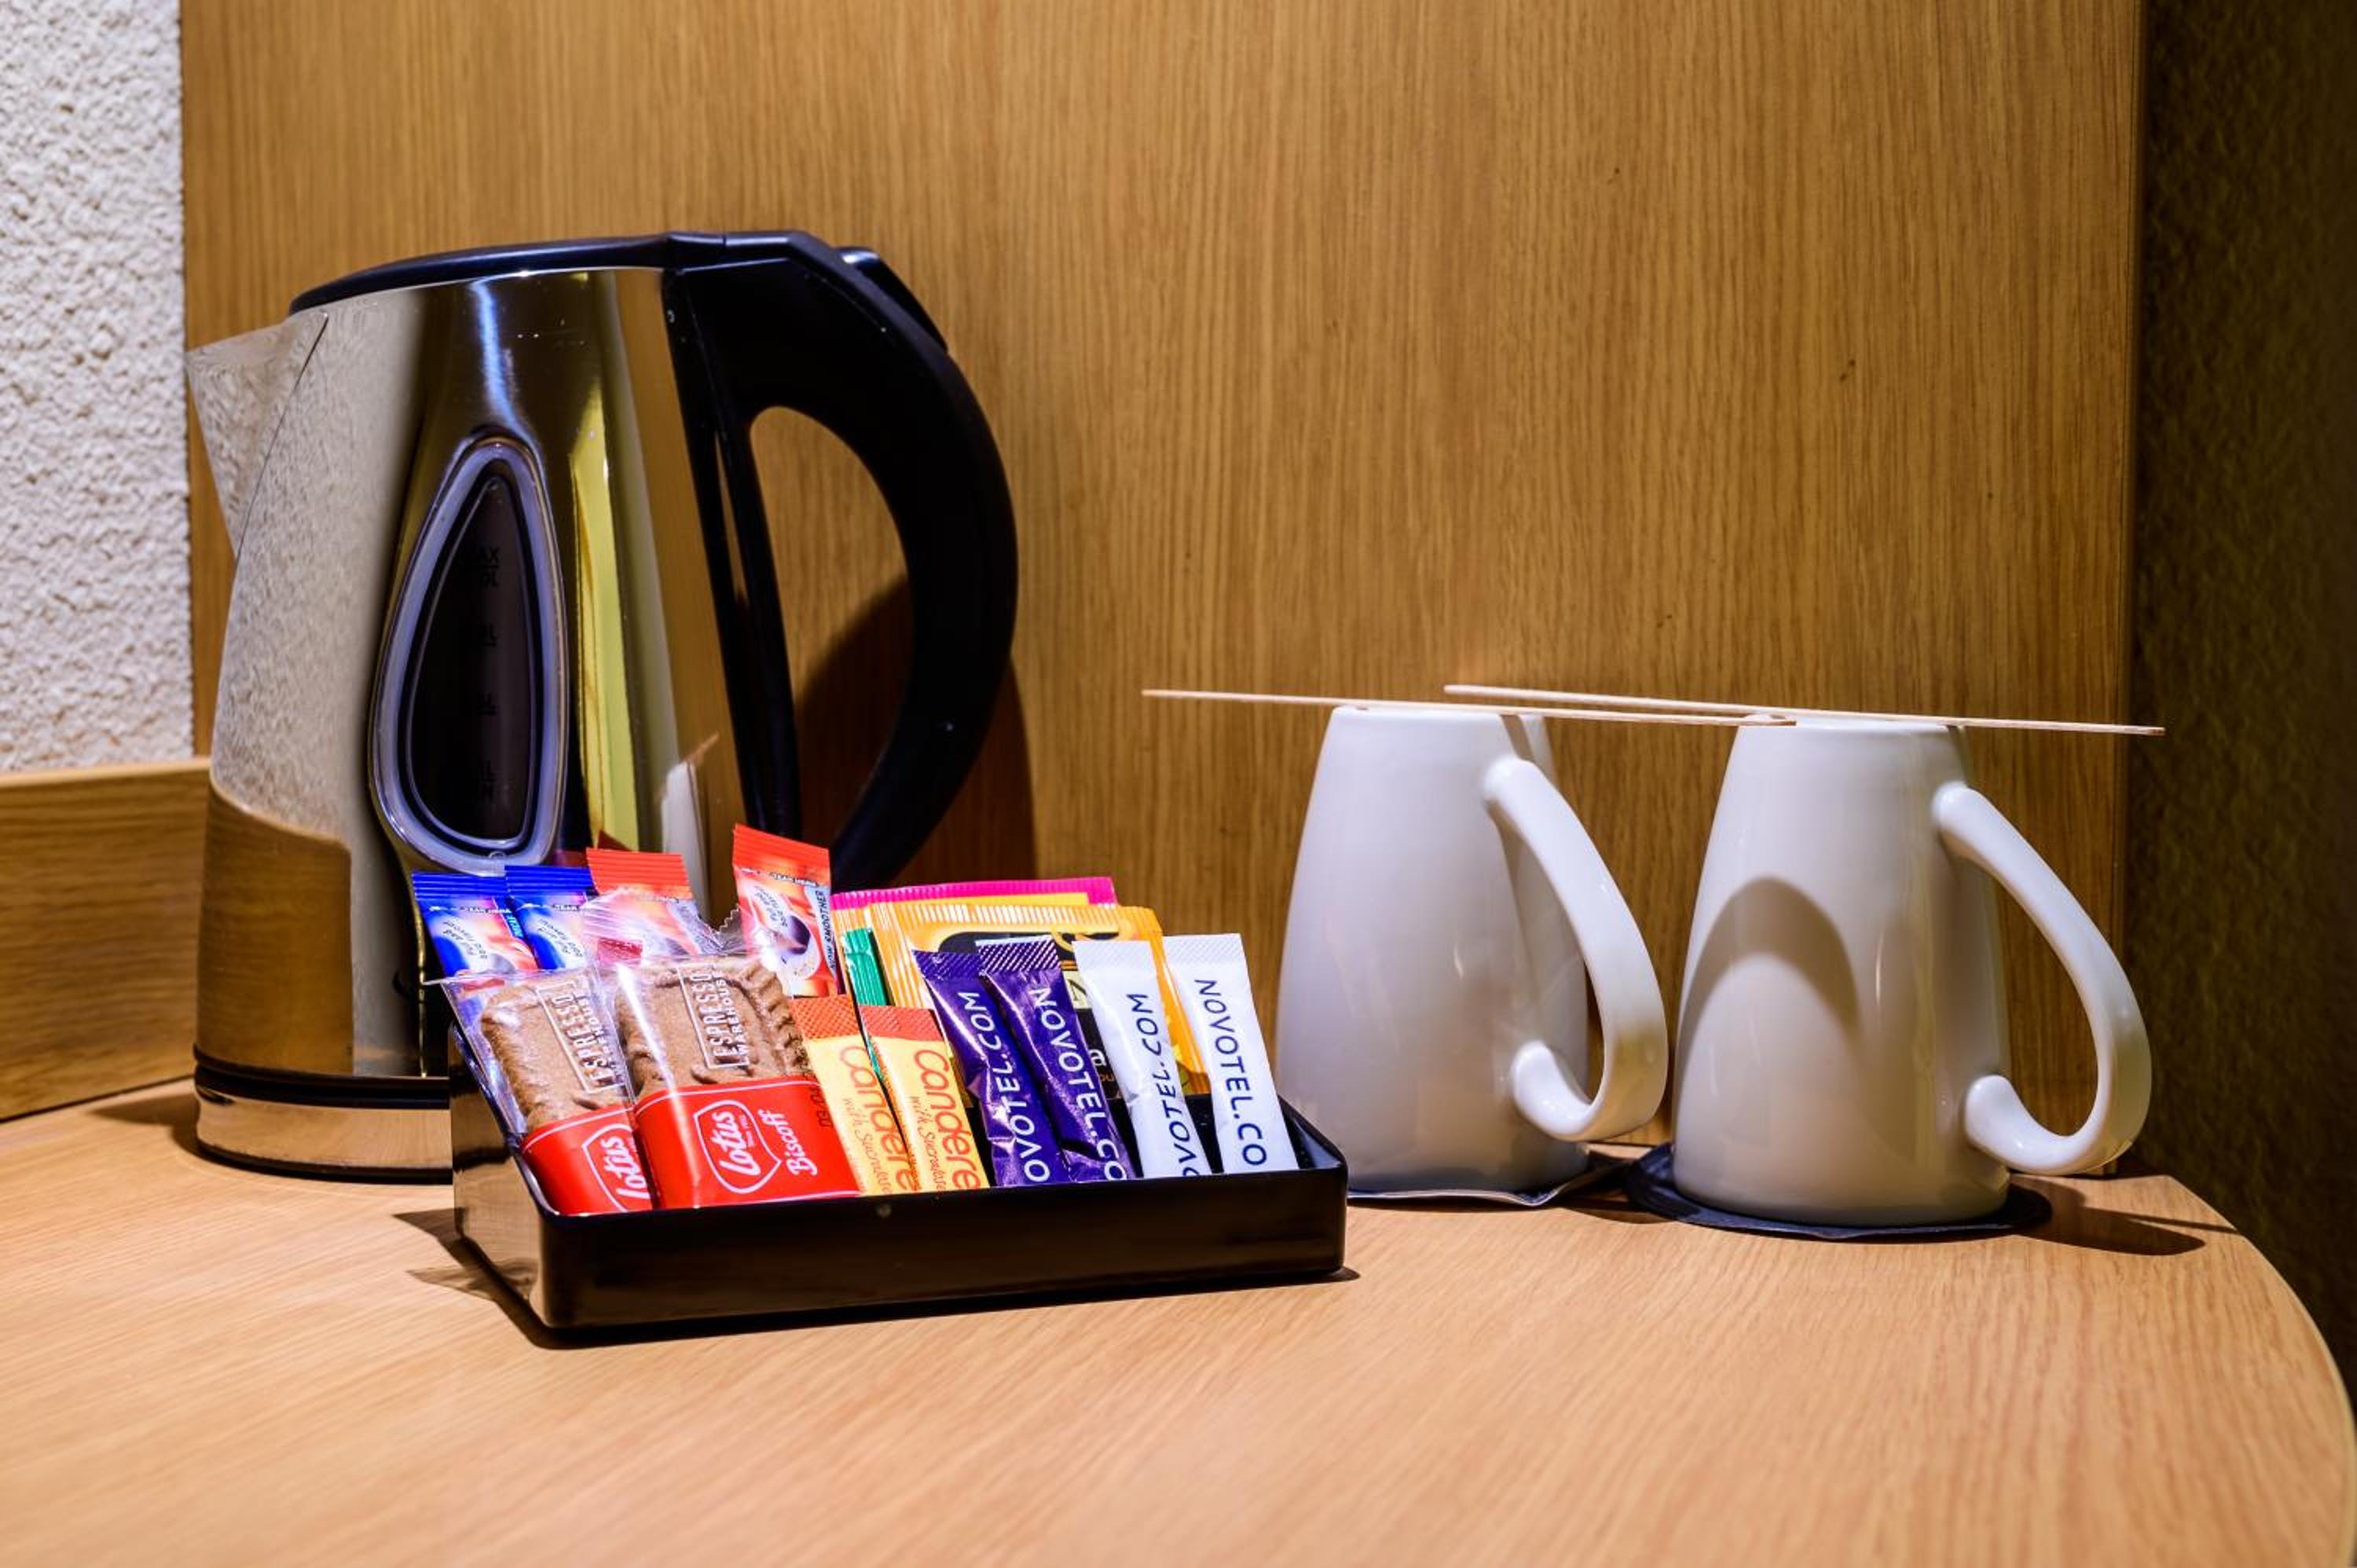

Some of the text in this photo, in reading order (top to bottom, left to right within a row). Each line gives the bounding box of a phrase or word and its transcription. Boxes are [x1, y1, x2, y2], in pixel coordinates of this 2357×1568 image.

[552, 993, 615, 1081] ESPRESSO
[690, 973, 734, 1057] ESPRESSO
[712, 969, 750, 1056] WAREHOUSE
[839, 1046, 914, 1191] Candere
[913, 1049, 981, 1190] Candere
[957, 991, 1050, 1182] OVOTEL.COM
[1028, 987, 1127, 1180] NOVOTEL.CO
[1194, 979, 1267, 1166] NOVOTEL.CO
[710, 1111, 762, 1176] Lotus
[757, 1108, 818, 1176] Biscoff
